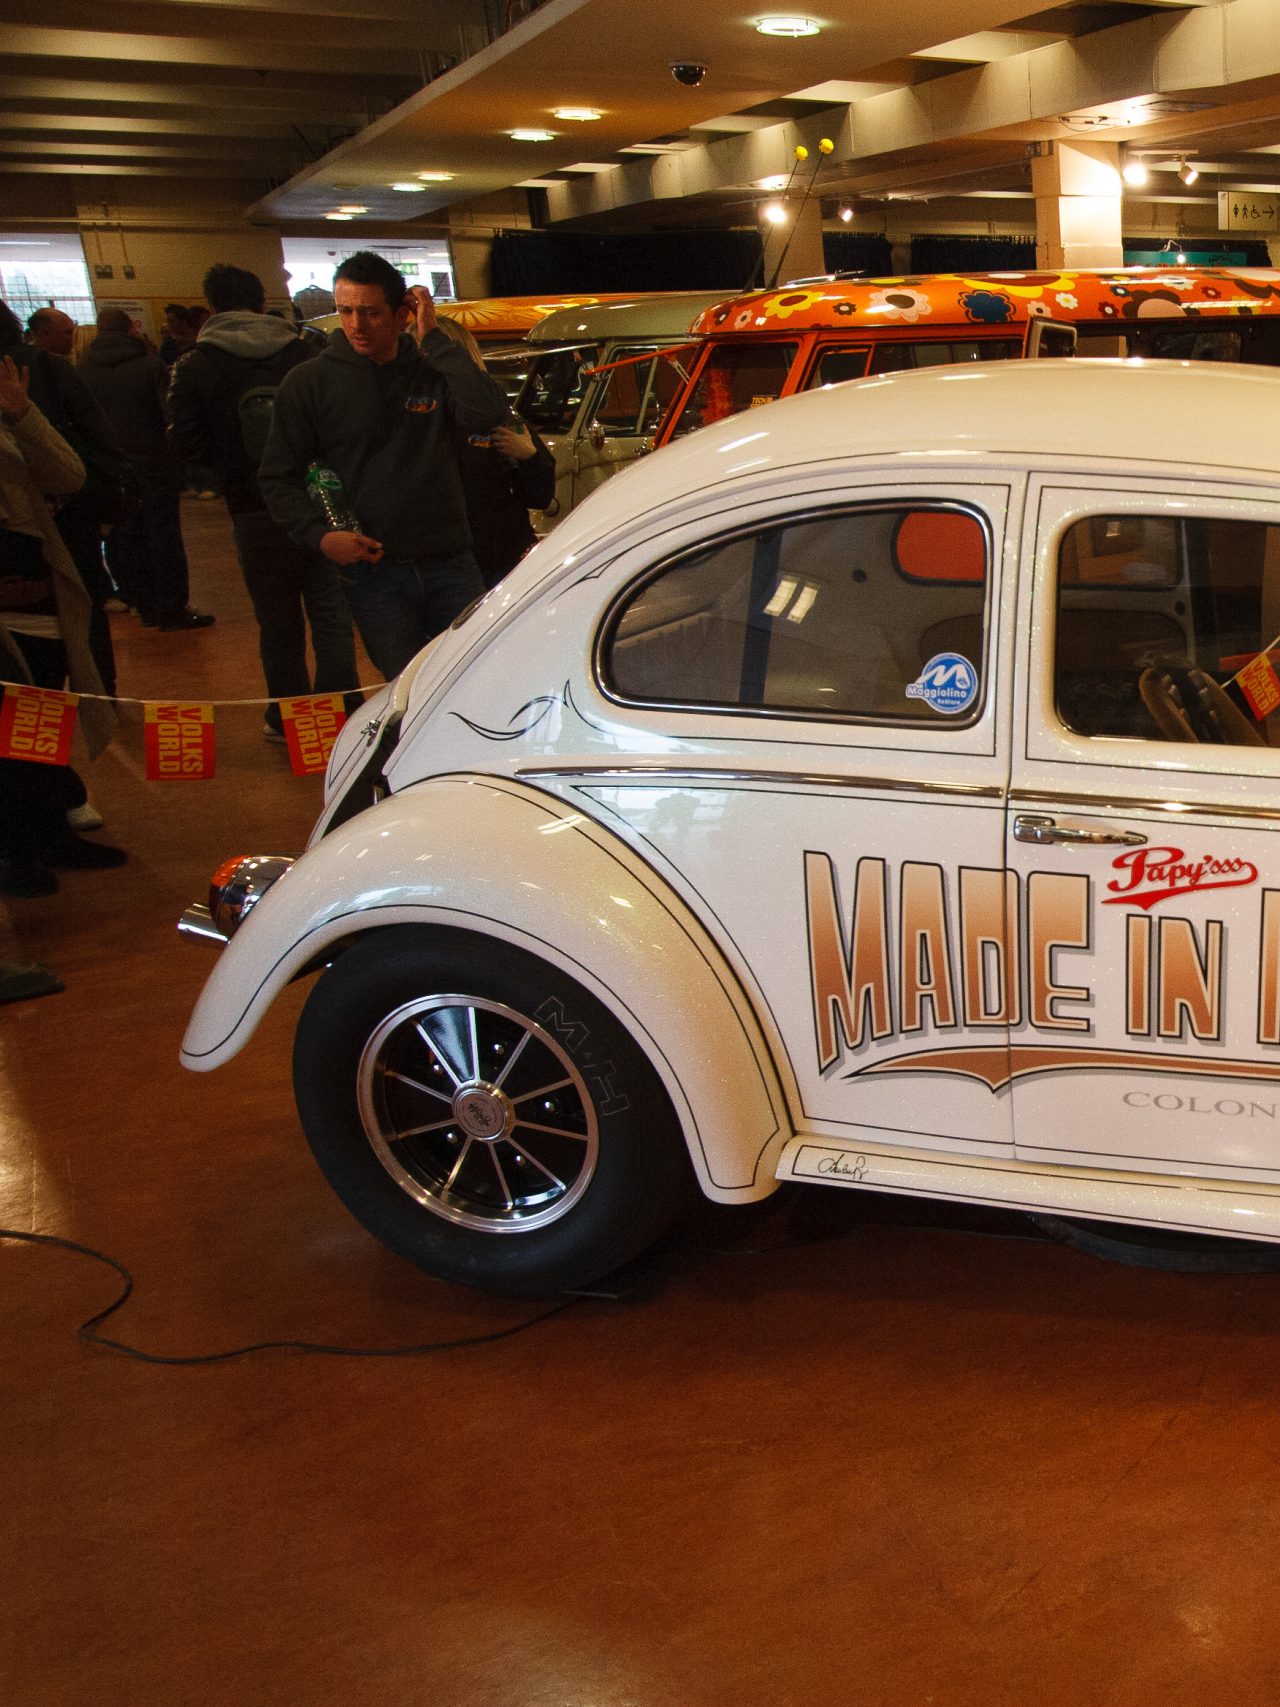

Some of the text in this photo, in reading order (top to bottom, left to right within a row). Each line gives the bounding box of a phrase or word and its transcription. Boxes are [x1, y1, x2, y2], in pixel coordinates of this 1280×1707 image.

[1252, 659, 1280, 705] VOLKS
[10, 686, 42, 751] WORLD
[35, 690, 67, 755] VOLKS
[156, 705, 181, 773] WORLD
[180, 706, 204, 773] VOLKS
[291, 699, 323, 767] WORLD
[313, 698, 338, 764] VOLKS
[803, 849, 1094, 1078] MADE
[1124, 914, 1225, 1042] IN
